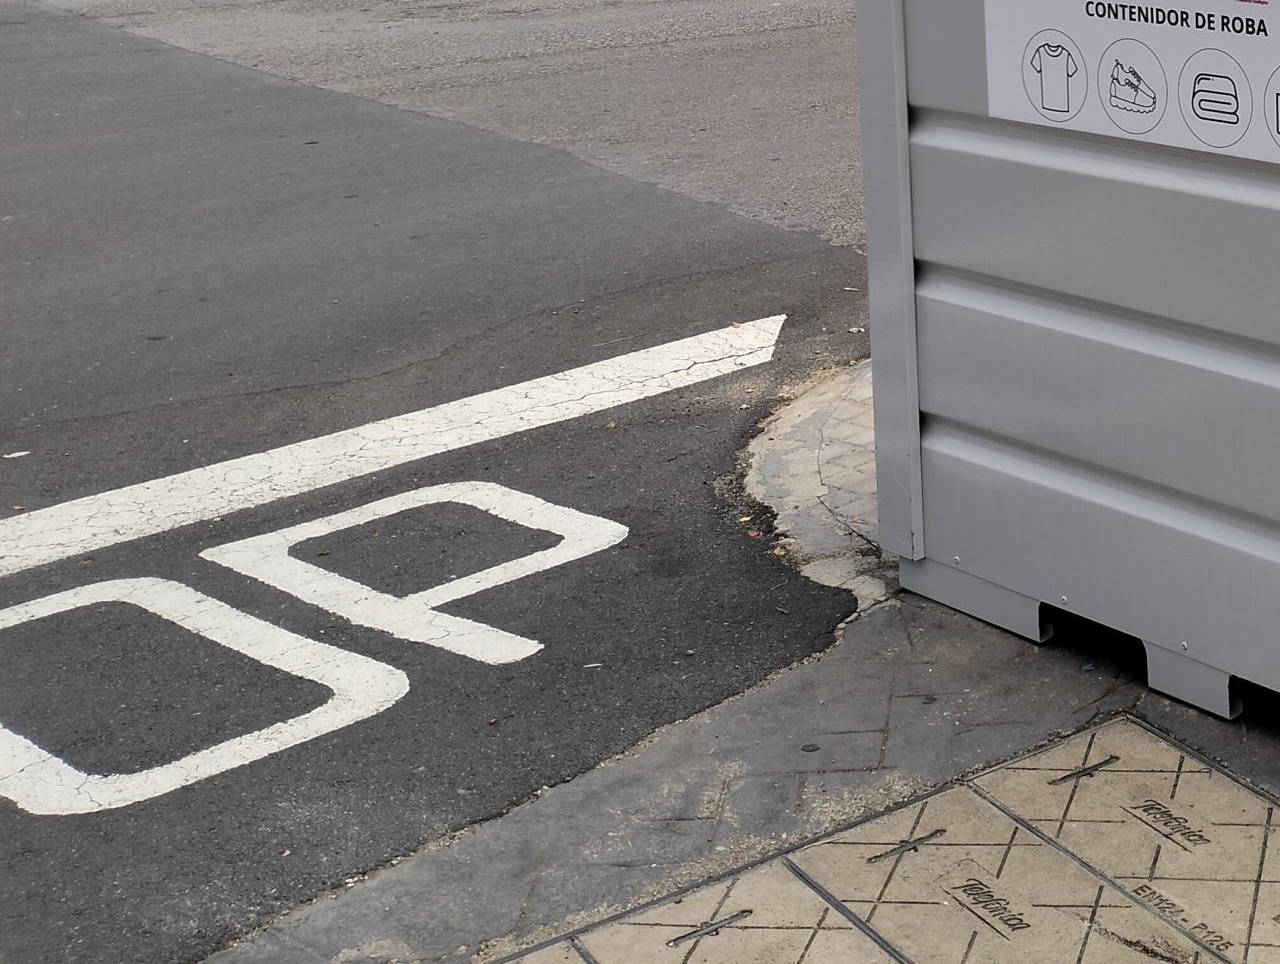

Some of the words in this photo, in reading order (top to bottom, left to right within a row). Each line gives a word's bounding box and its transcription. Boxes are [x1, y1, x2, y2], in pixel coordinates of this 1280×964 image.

[1085, 0, 1190, 28] CONTENIDOR
[1195, 12, 1216, 30] DE
[1221, 16, 1269, 37] ROBA
